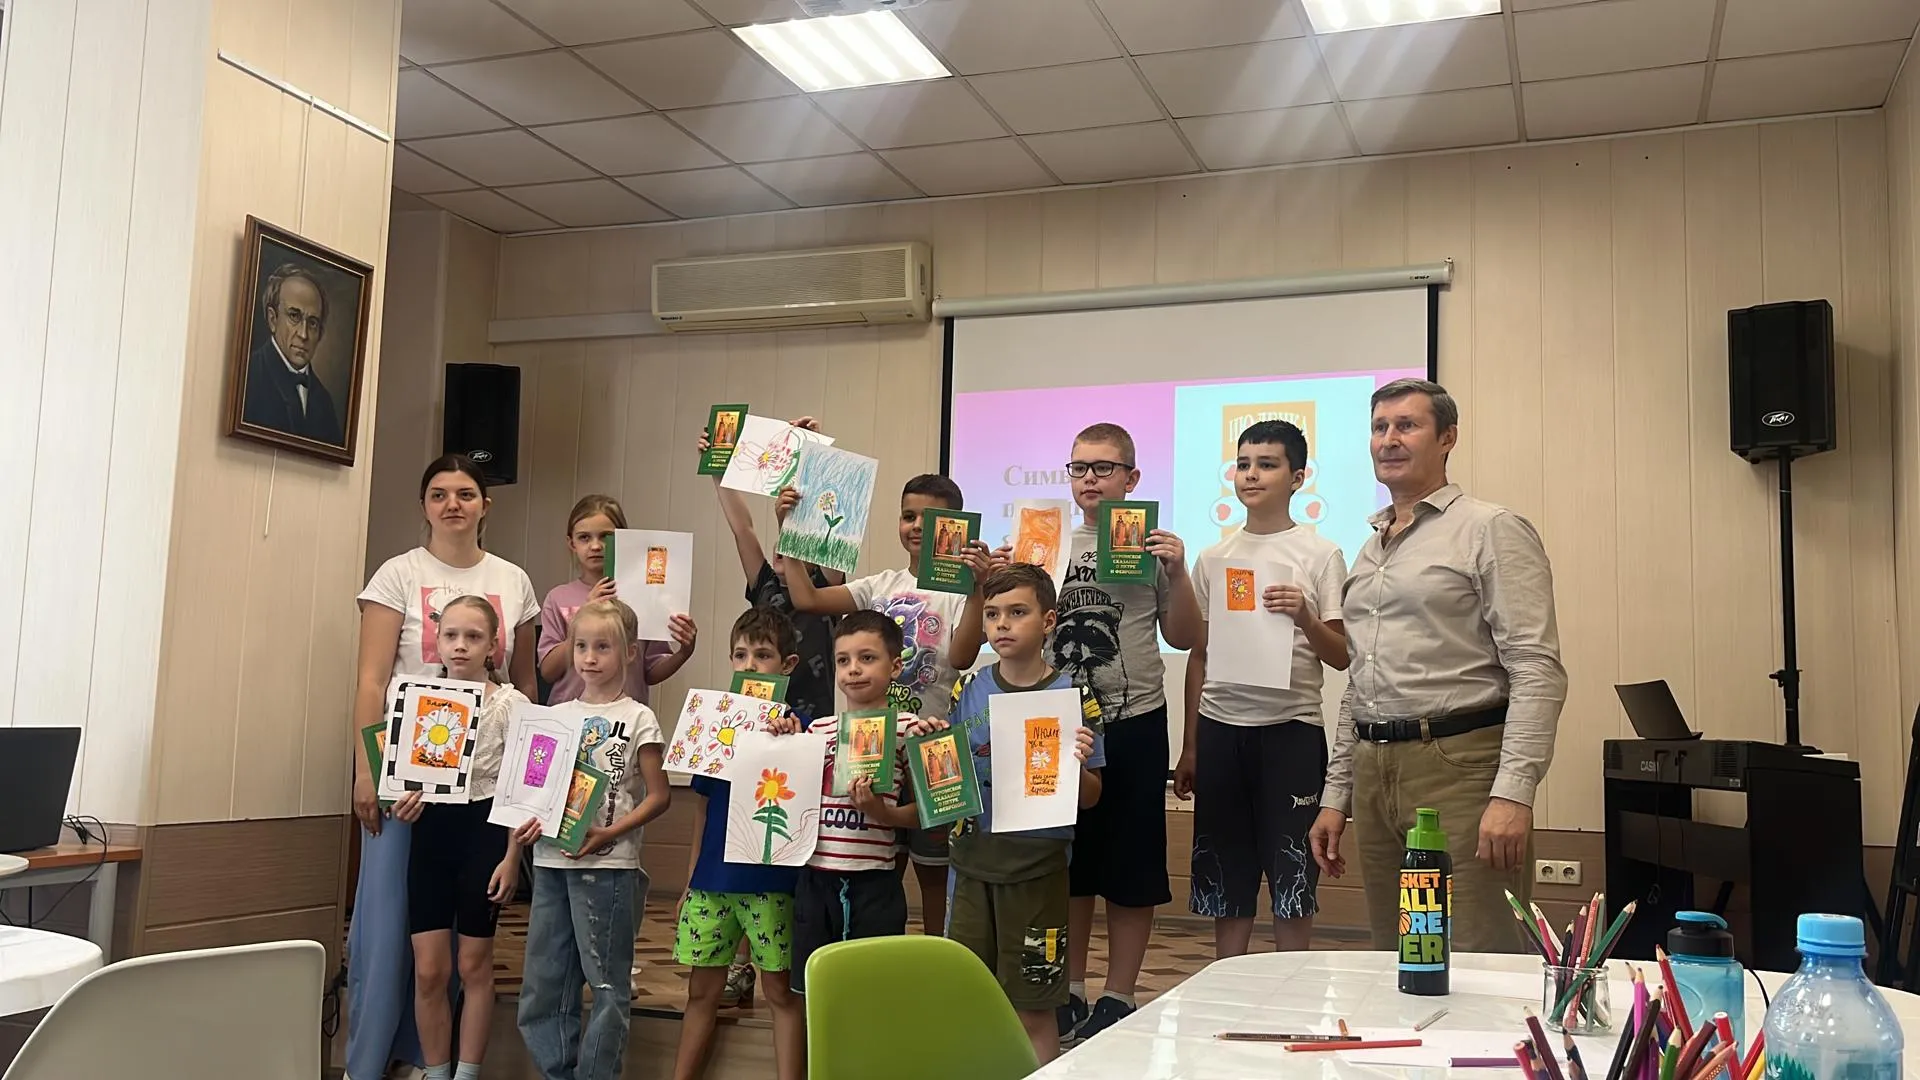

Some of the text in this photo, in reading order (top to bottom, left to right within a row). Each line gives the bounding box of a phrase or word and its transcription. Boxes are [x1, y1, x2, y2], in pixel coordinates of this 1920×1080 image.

[443, 581, 464, 596] this
[824, 808, 869, 831] COOL
[1399, 934, 1445, 963] ER
